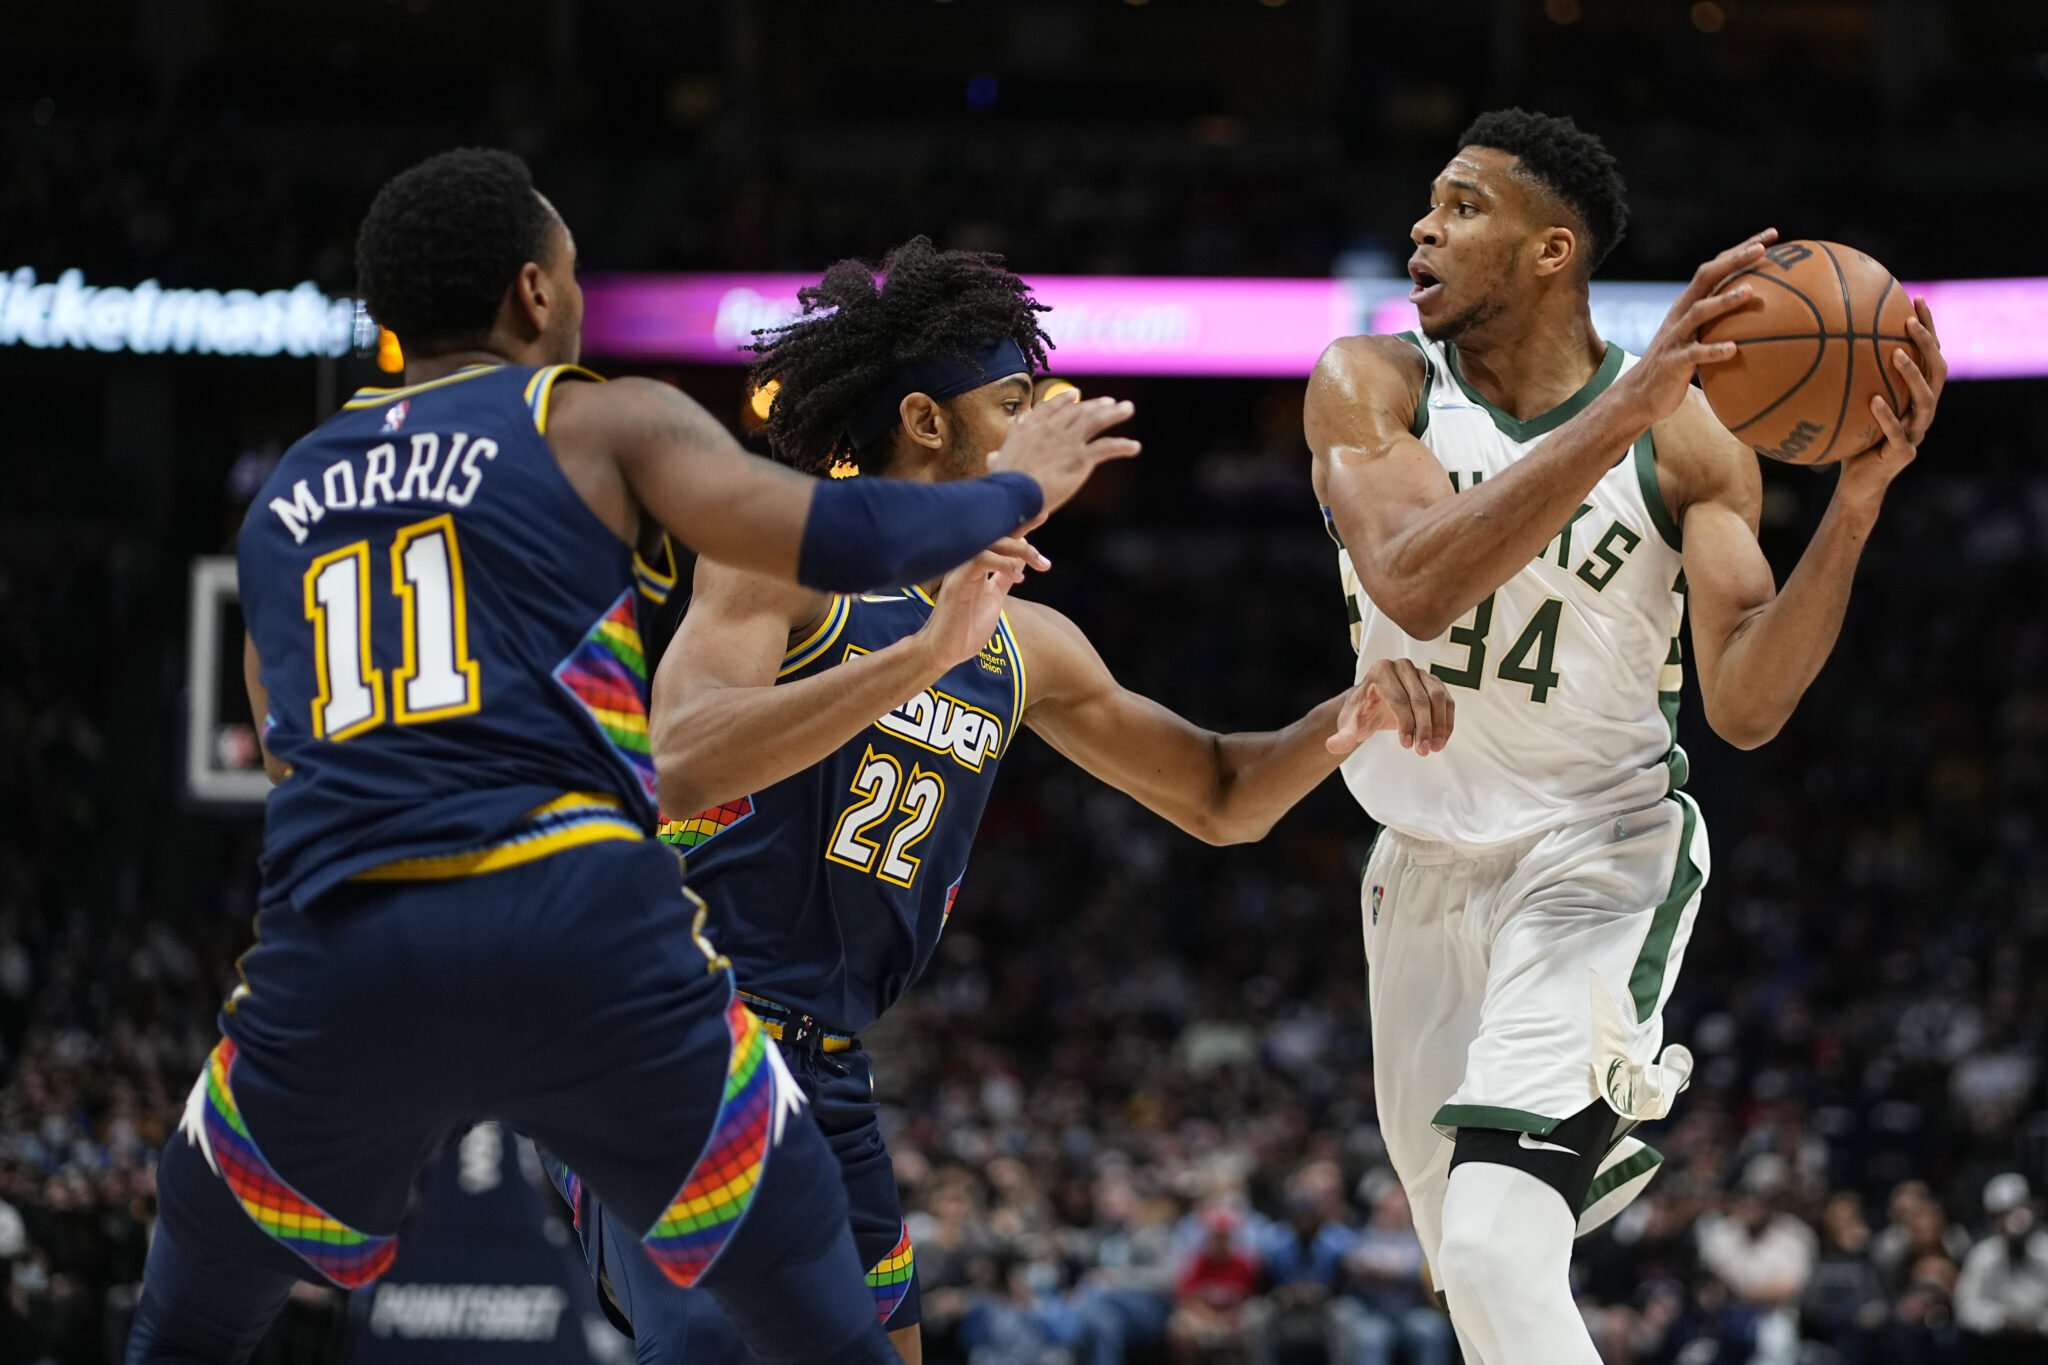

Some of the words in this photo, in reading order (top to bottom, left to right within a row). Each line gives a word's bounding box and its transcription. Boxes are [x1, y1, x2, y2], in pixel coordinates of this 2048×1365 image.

[269, 432, 498, 543] MORRIS
[304, 513, 481, 741] 11
[980, 658, 1003, 675] Union
[1428, 590, 1564, 705] 34
[825, 743, 945, 888] 22
